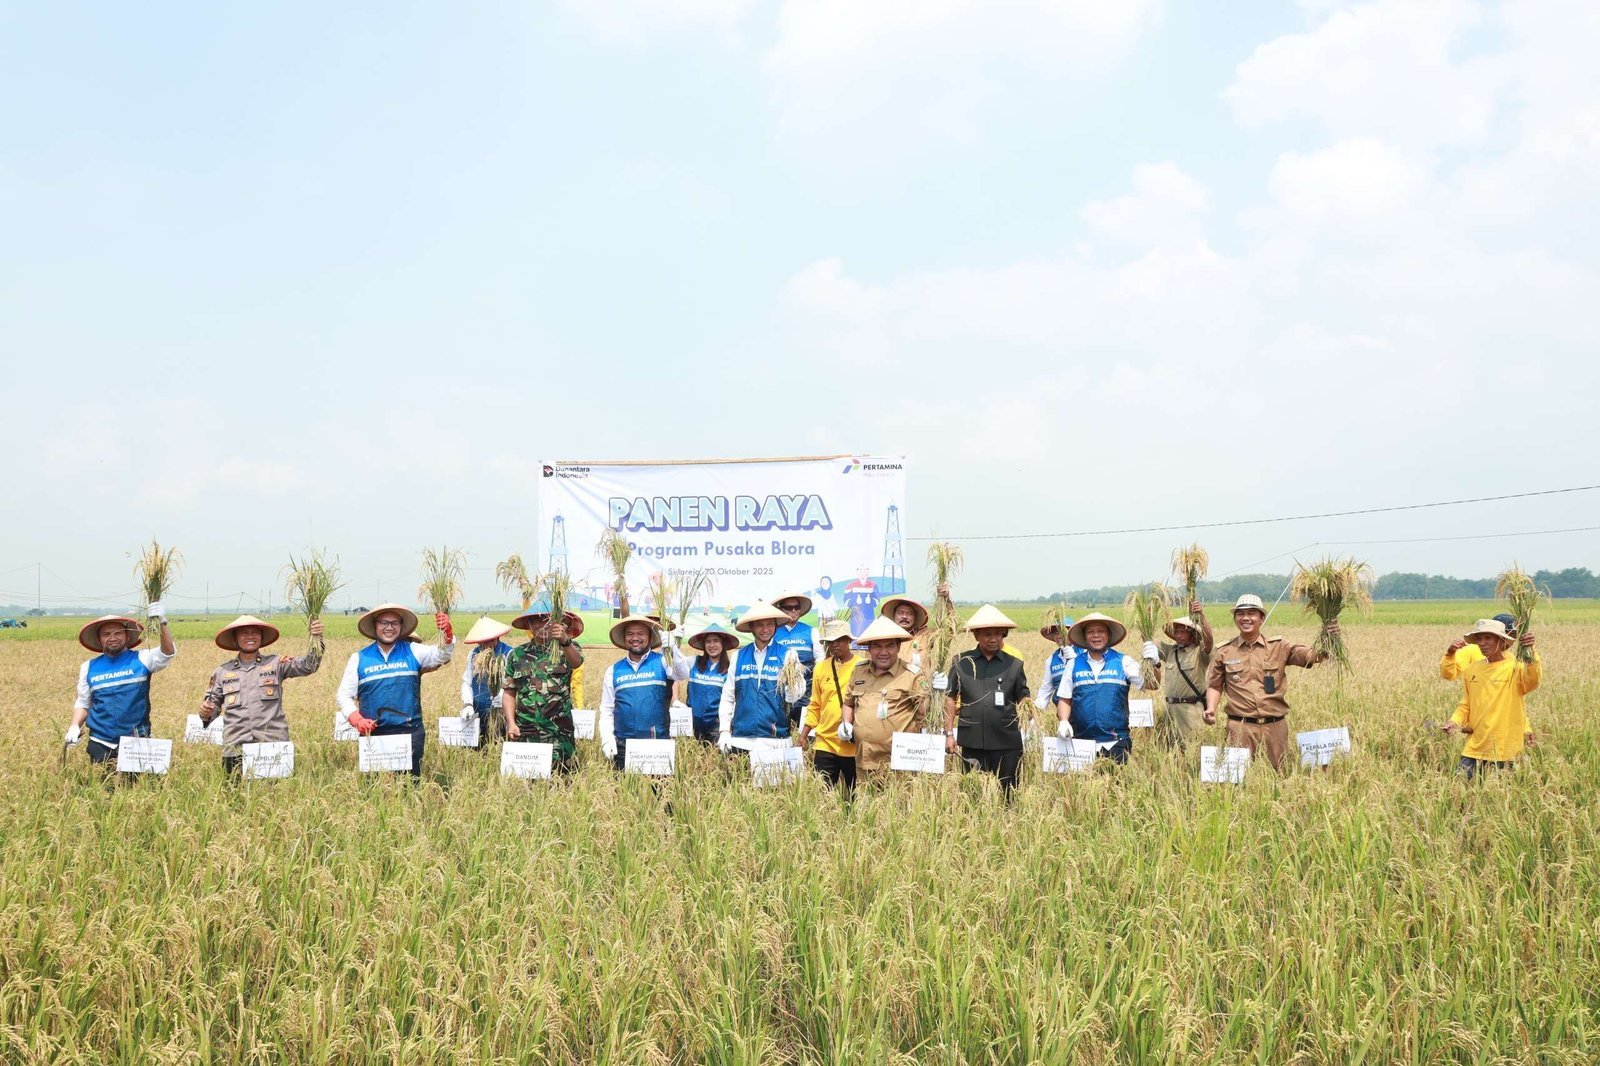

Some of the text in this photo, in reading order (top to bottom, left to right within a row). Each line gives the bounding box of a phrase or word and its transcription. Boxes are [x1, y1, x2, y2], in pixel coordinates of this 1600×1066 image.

[608, 494, 834, 532] PANEN RAYA
[628, 540, 815, 559] Program Pusaka Blora
[705, 568, 714, 576] 20
[717, 567, 750, 576] Oktober
[752, 567, 774, 576] 2025
[364, 662, 408, 674] PERTAMINA
[90, 670, 134, 684] PERTAMINA
[616, 672, 656, 683] PERTAMINA
